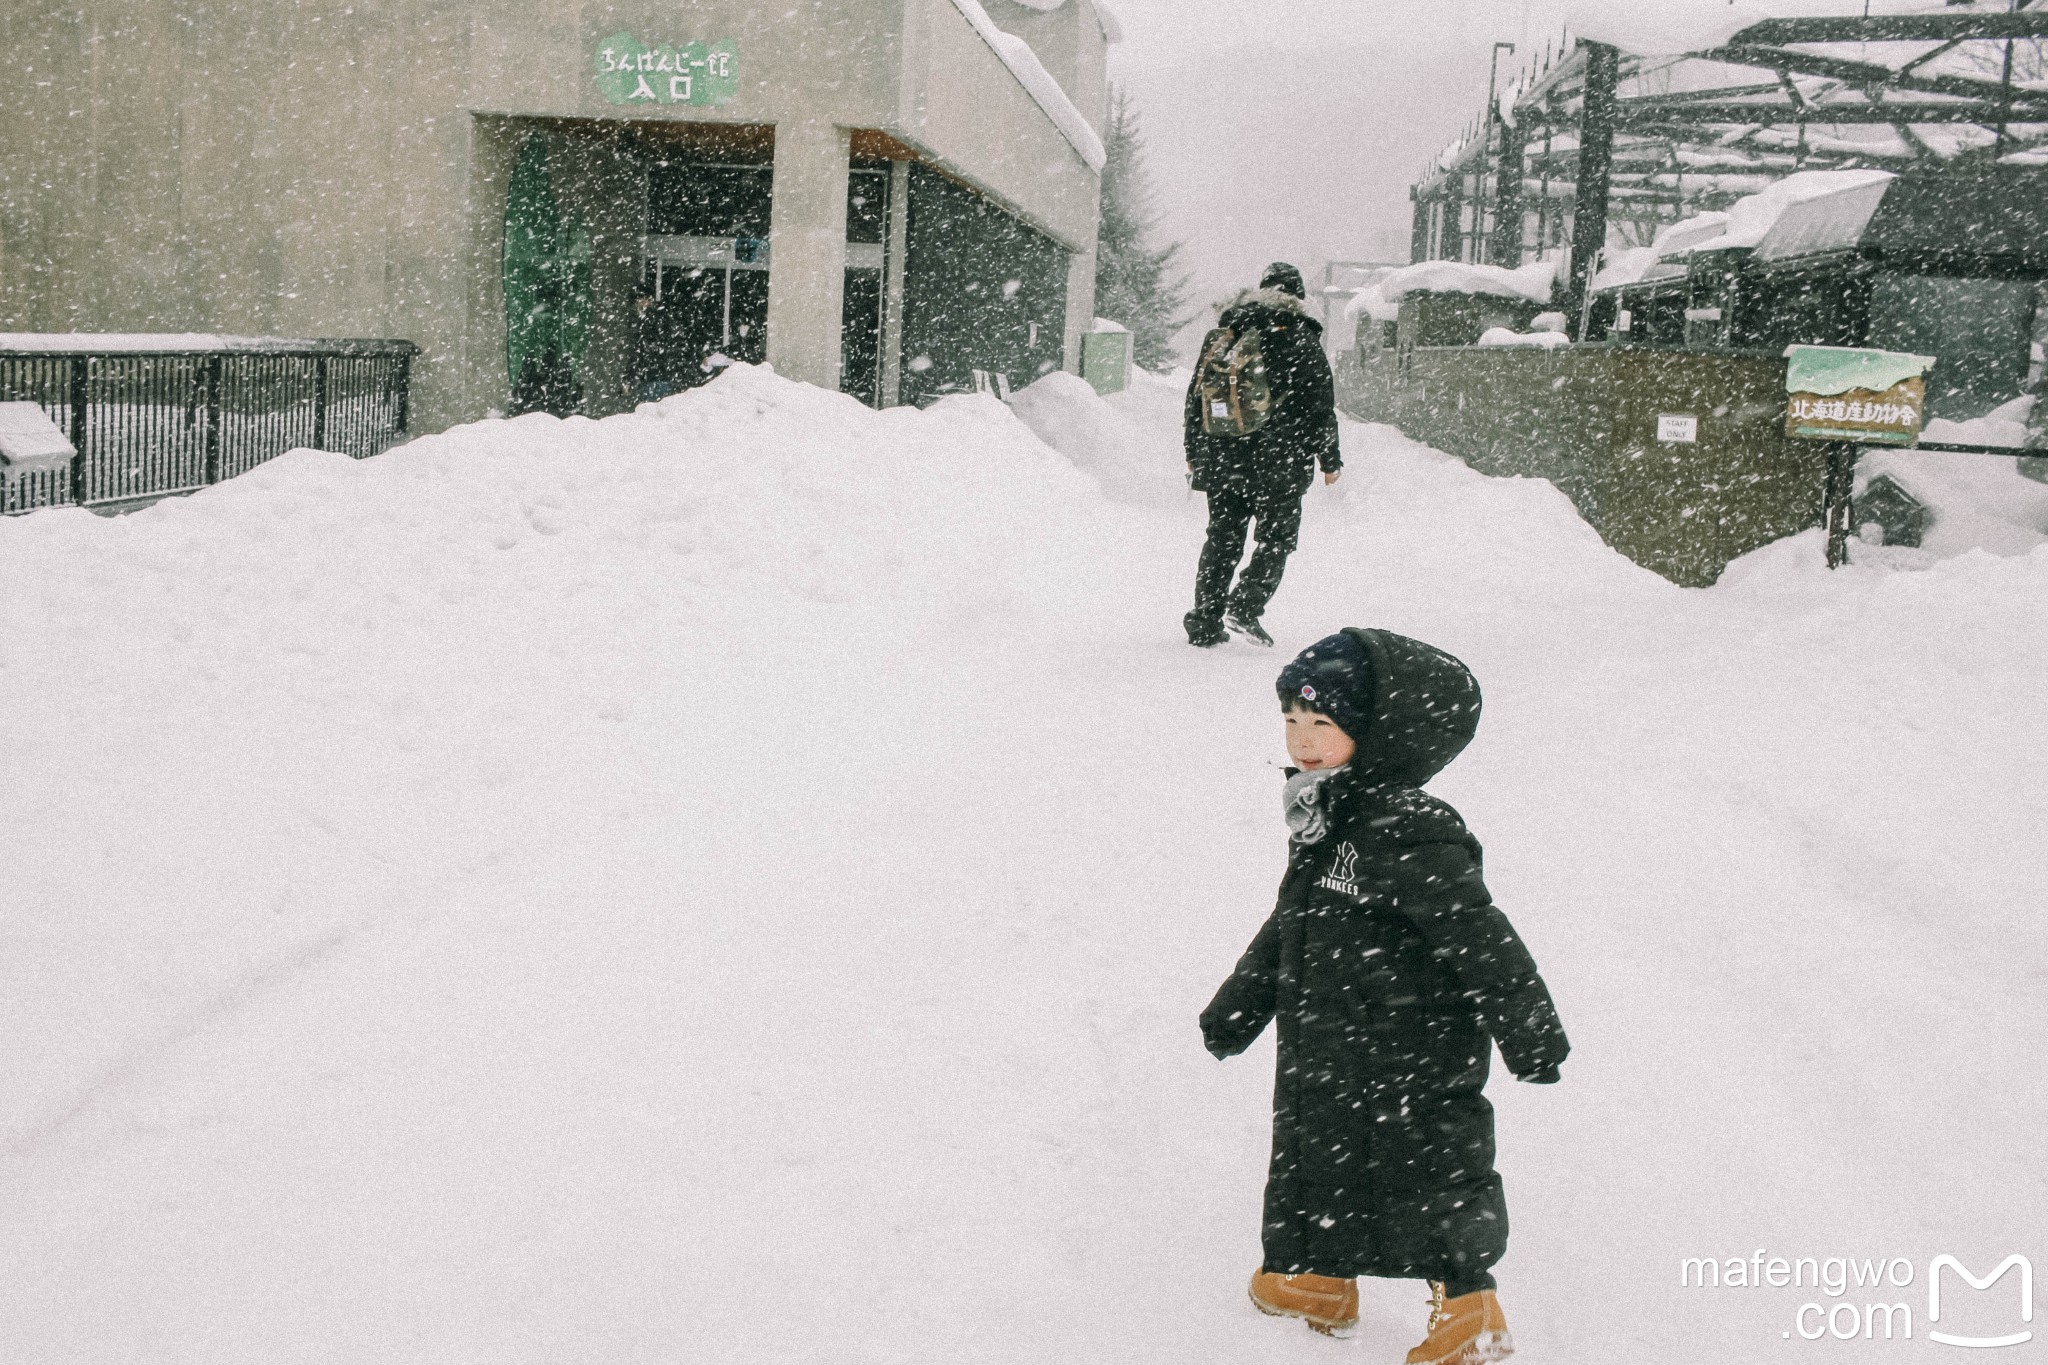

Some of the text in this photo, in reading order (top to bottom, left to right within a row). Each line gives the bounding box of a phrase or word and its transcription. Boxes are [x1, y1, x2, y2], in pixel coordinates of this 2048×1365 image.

[601, 48, 730, 77] ちんぱんじー館
[628, 75, 692, 100] 入口
[1791, 400, 1918, 426] 北海道産動物舎
[1320, 876, 1359, 896] YANKEES
